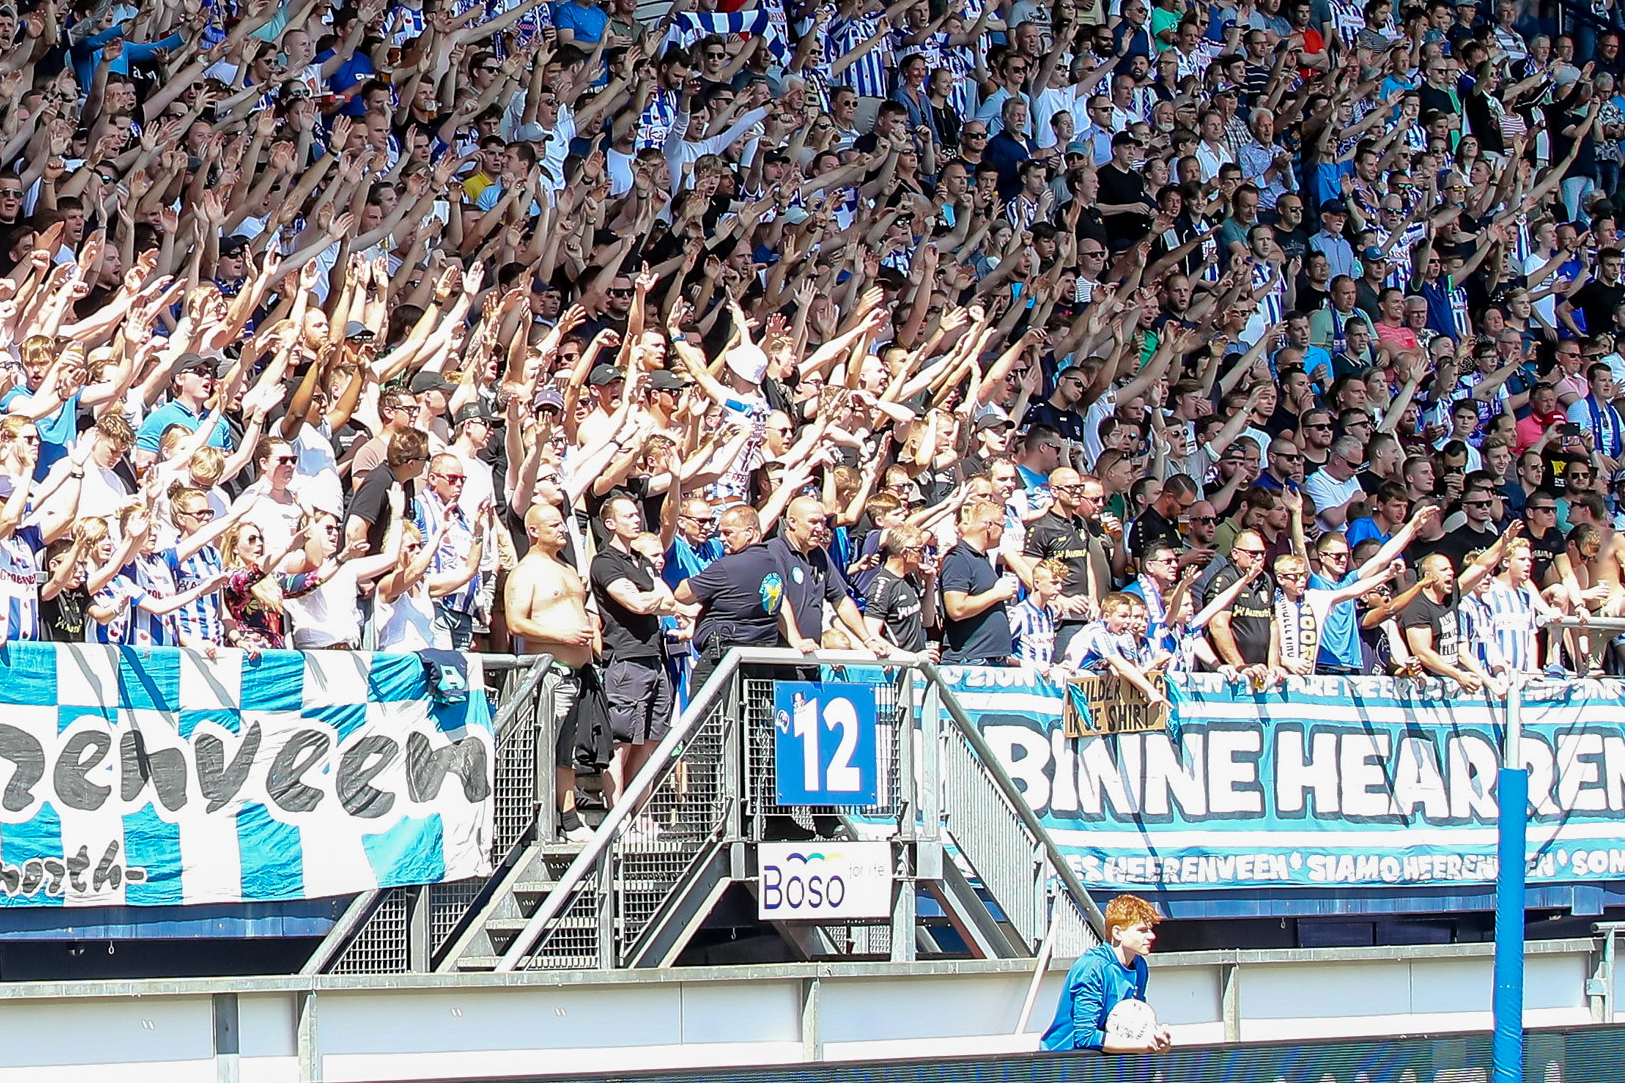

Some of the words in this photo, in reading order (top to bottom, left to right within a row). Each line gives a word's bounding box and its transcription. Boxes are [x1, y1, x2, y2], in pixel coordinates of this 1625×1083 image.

[1106, 702, 1150, 731] SHIRT
[793, 696, 861, 792] 12
[981, 724, 1262, 815] BINNE
[764, 865, 846, 909] Boso
[1104, 854, 1290, 884] HEERENVEEN
[1306, 853, 1402, 882] SIAMO
[1402, 852, 1556, 880] HEERENEN
